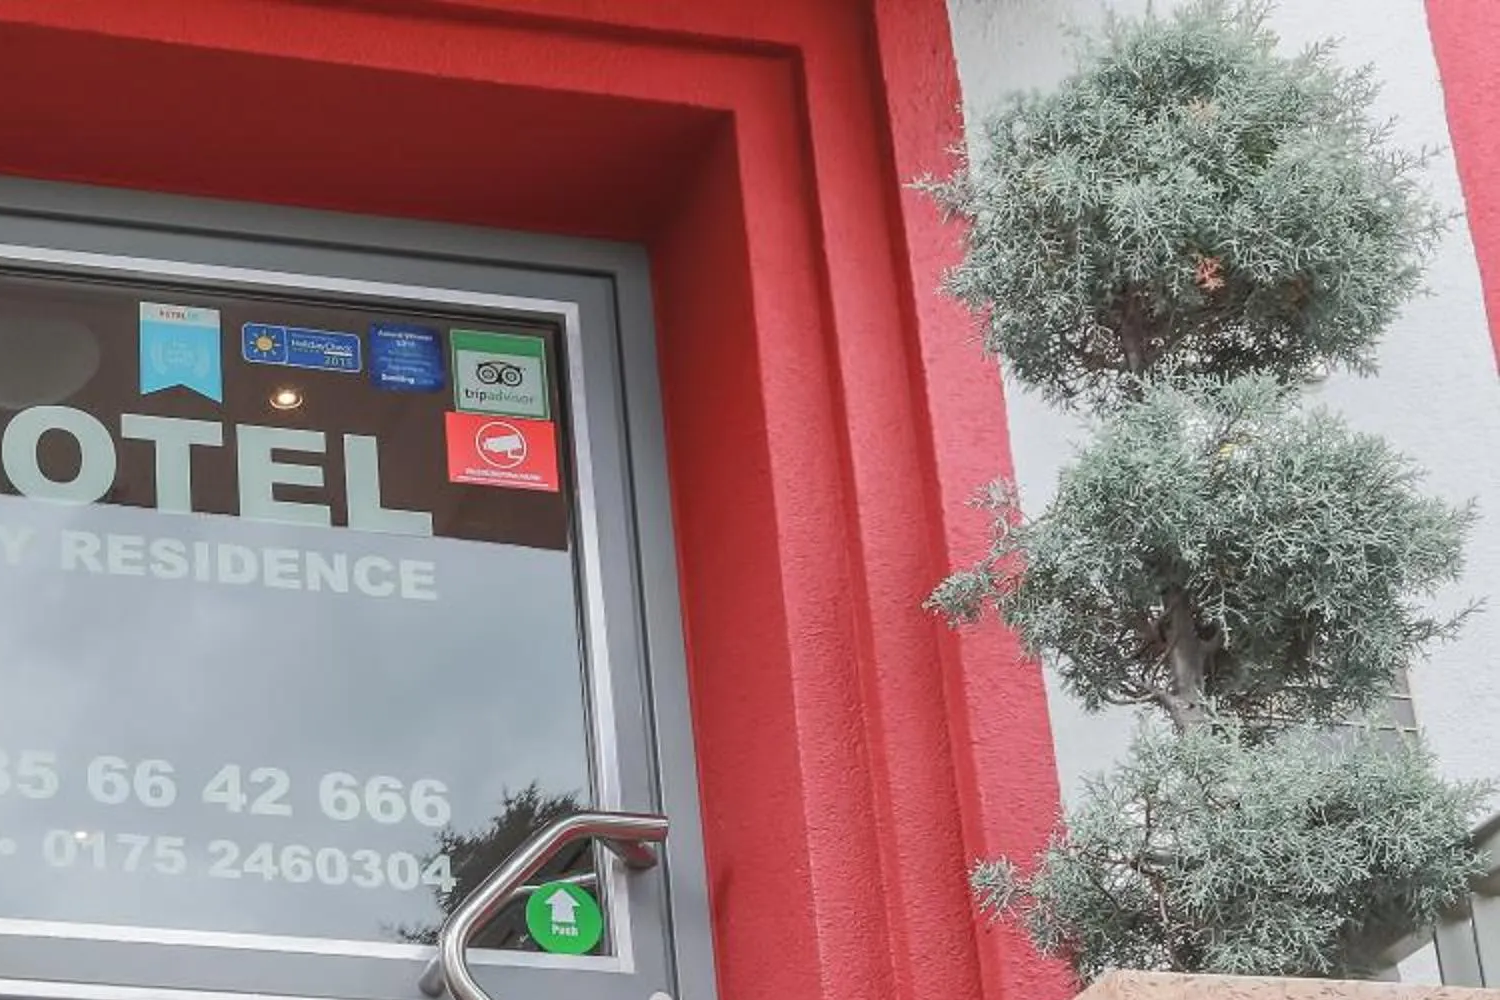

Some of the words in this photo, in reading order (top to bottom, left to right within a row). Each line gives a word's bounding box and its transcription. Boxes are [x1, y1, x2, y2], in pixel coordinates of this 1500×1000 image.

[465, 387, 535, 405] tripadvisor
[60, 529, 438, 600] RESIDENCE
[87, 755, 178, 808] 66
[202, 764, 293, 817] 42
[318, 770, 453, 828] 666
[43, 829, 188, 875] 0175
[207, 838, 457, 893] 2460304
[551, 923, 579, 937] Push
